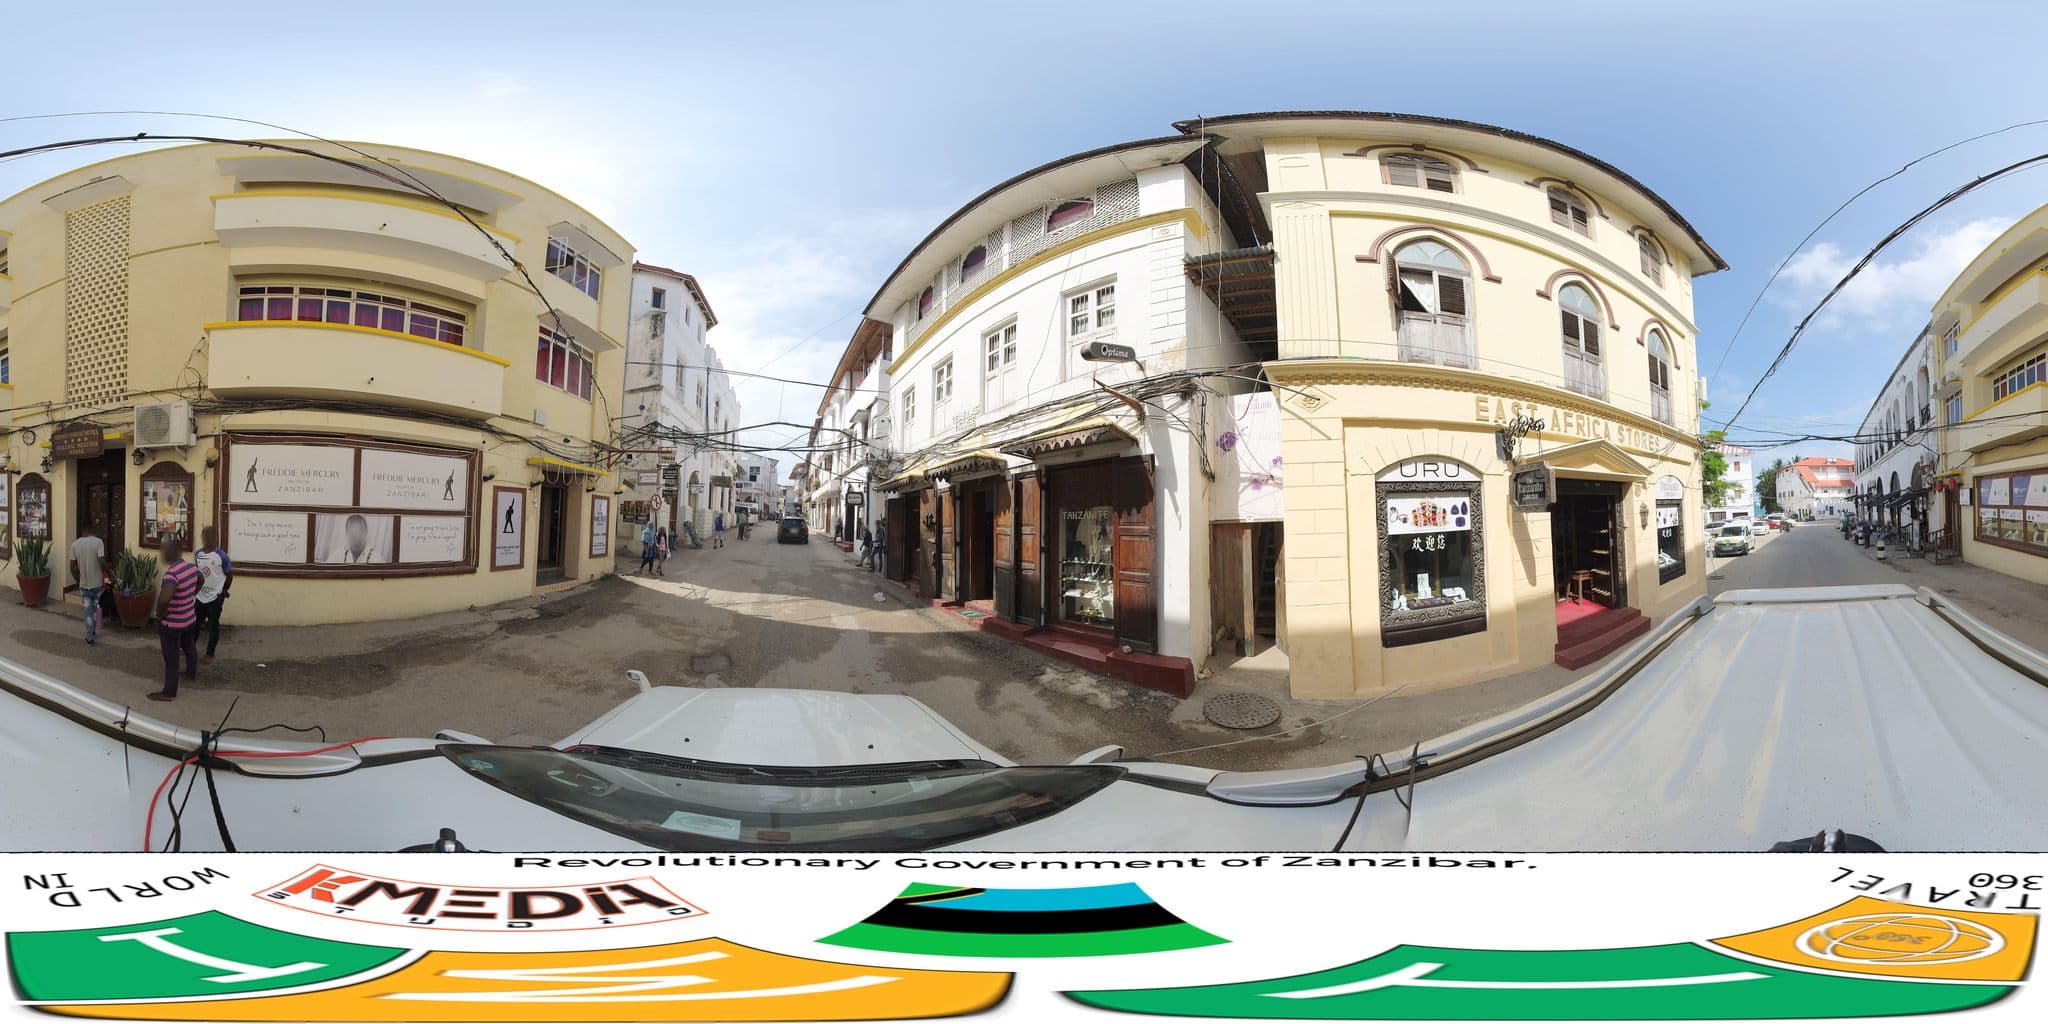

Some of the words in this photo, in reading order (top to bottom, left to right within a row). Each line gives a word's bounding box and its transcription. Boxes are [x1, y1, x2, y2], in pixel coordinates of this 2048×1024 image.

[1475, 395, 1538, 424] EAST
[1551, 409, 1611, 441] AFRICA
[1617, 424, 1660, 453] STORES
[262, 468, 298, 478] FREDDIE
[301, 469, 341, 479] MERCURY
[1400, 462, 1460, 478] URU
[373, 473, 403, 482] FREDDIE
[407, 475, 440, 485] MERCURY
